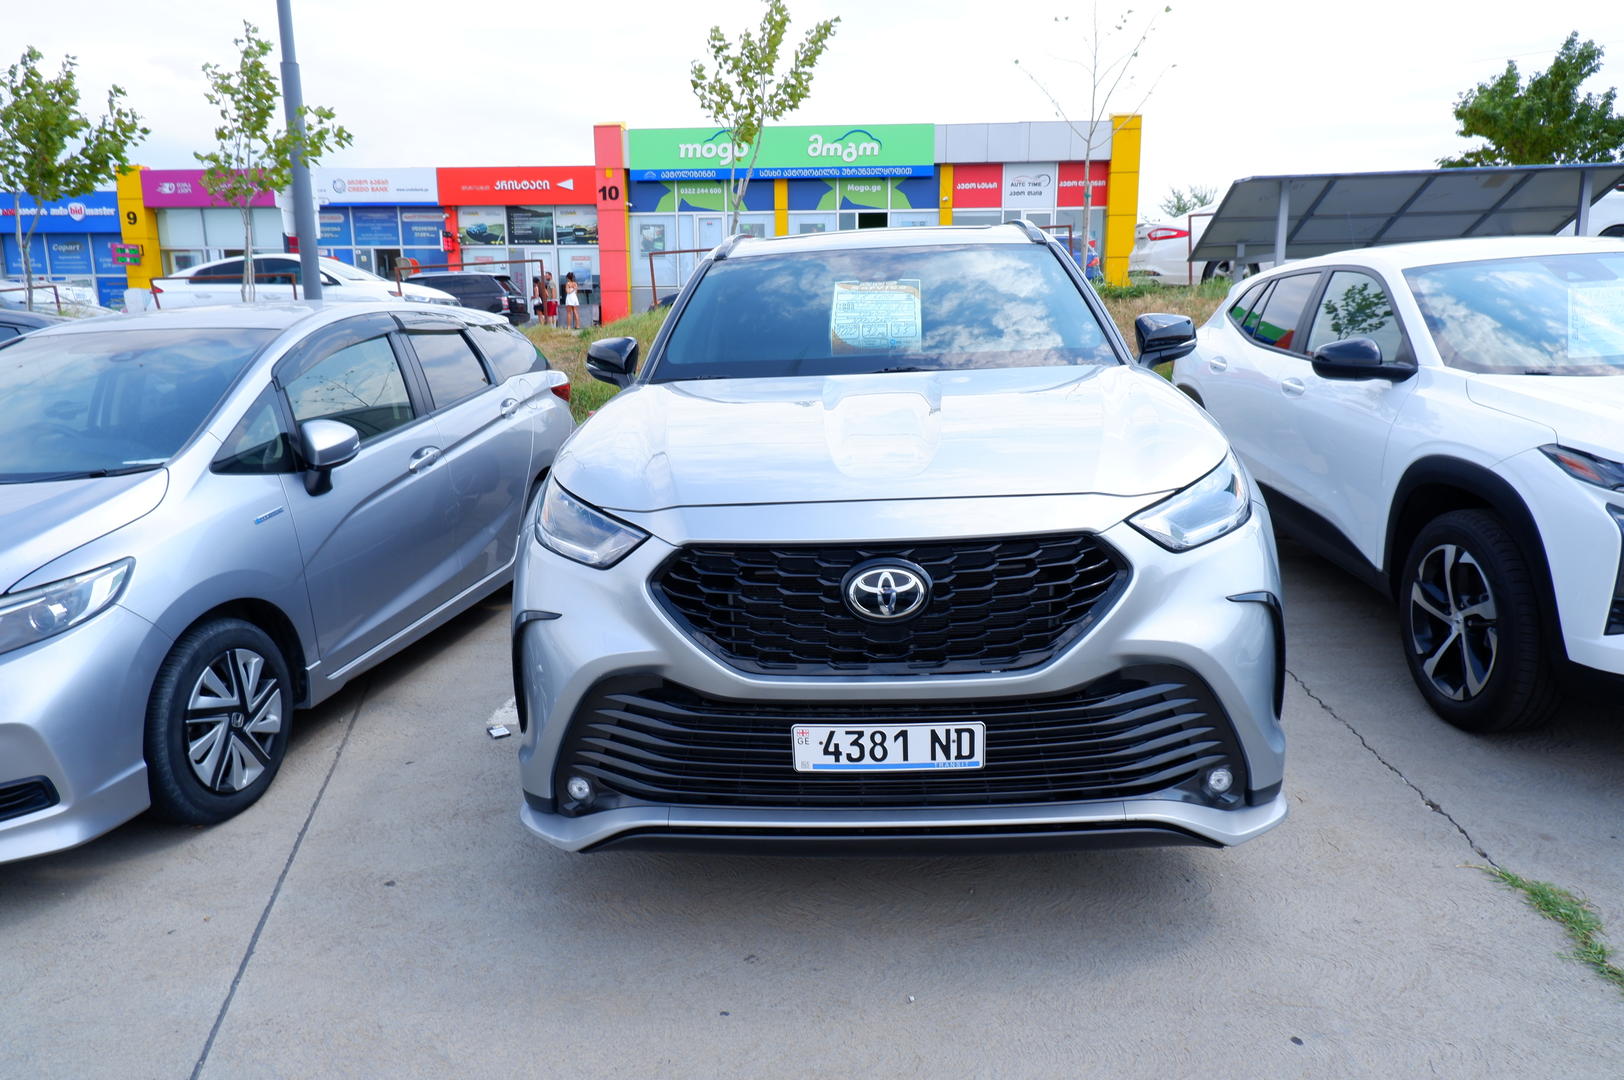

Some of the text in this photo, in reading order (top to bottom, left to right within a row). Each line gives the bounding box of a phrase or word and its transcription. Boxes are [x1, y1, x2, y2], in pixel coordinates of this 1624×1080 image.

[679, 142, 749, 166] mogo
[807, 134, 879, 162] მოგო
[598, 186, 620, 200] 10
[126, 211, 138, 225] 9
[797, 738, 810, 746] GE
[822, 728, 975, 763] 4381 ND
